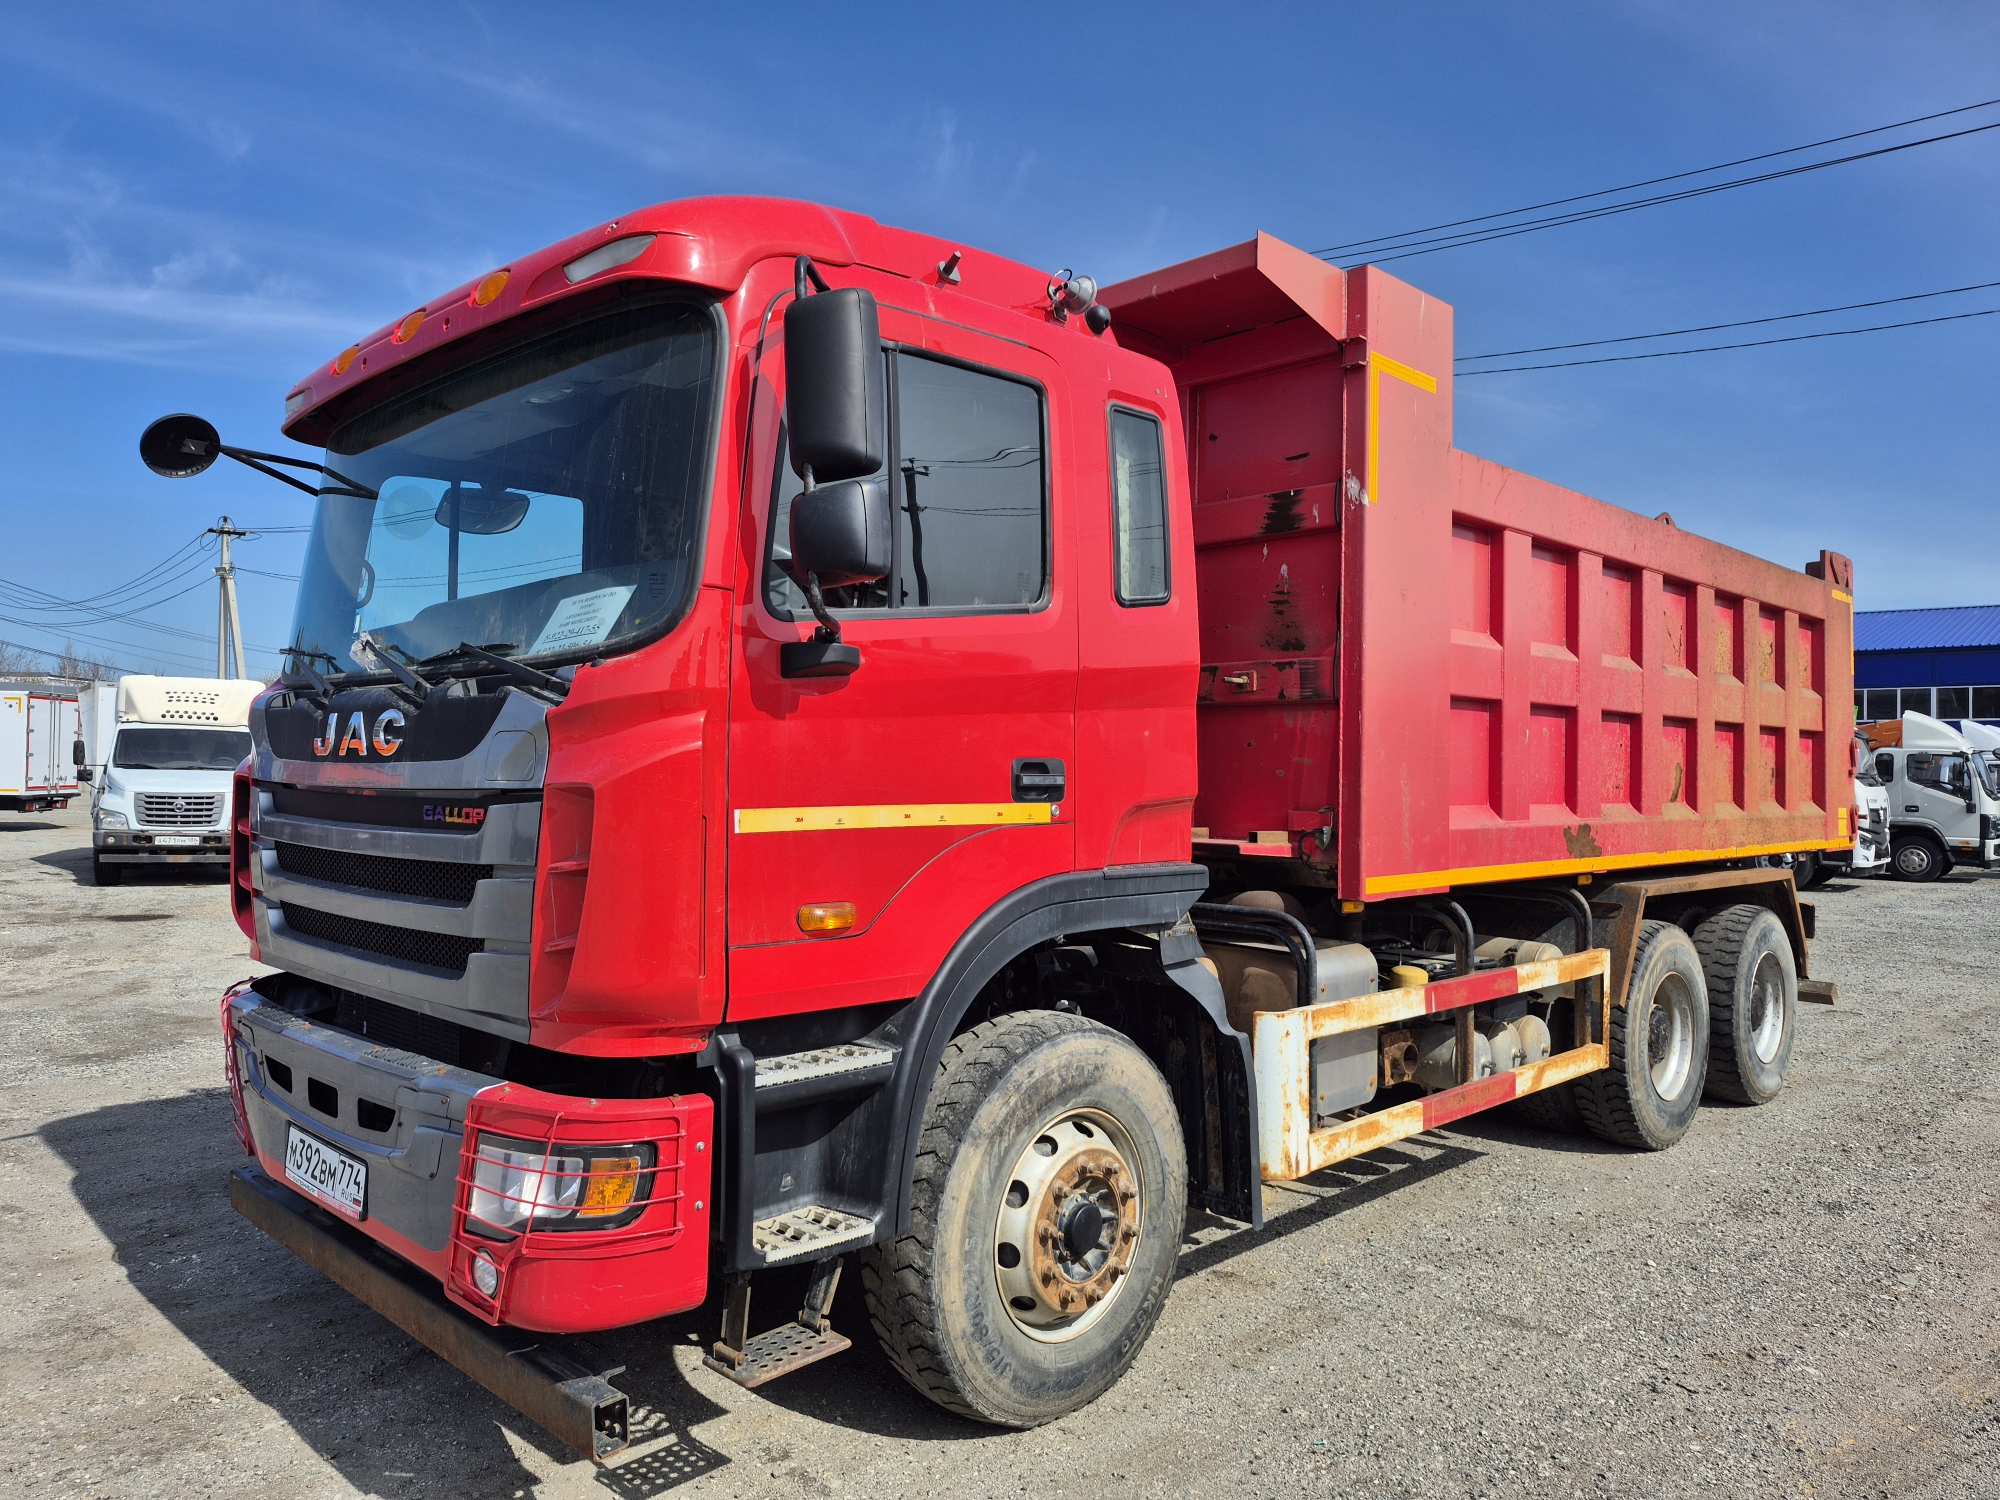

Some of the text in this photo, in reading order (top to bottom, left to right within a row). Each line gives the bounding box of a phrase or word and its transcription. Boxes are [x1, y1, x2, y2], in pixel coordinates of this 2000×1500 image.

[313, 708, 405, 757] JAC
[422, 805, 487, 825] GALLOP
[341, 1189, 353, 1202] RUS
